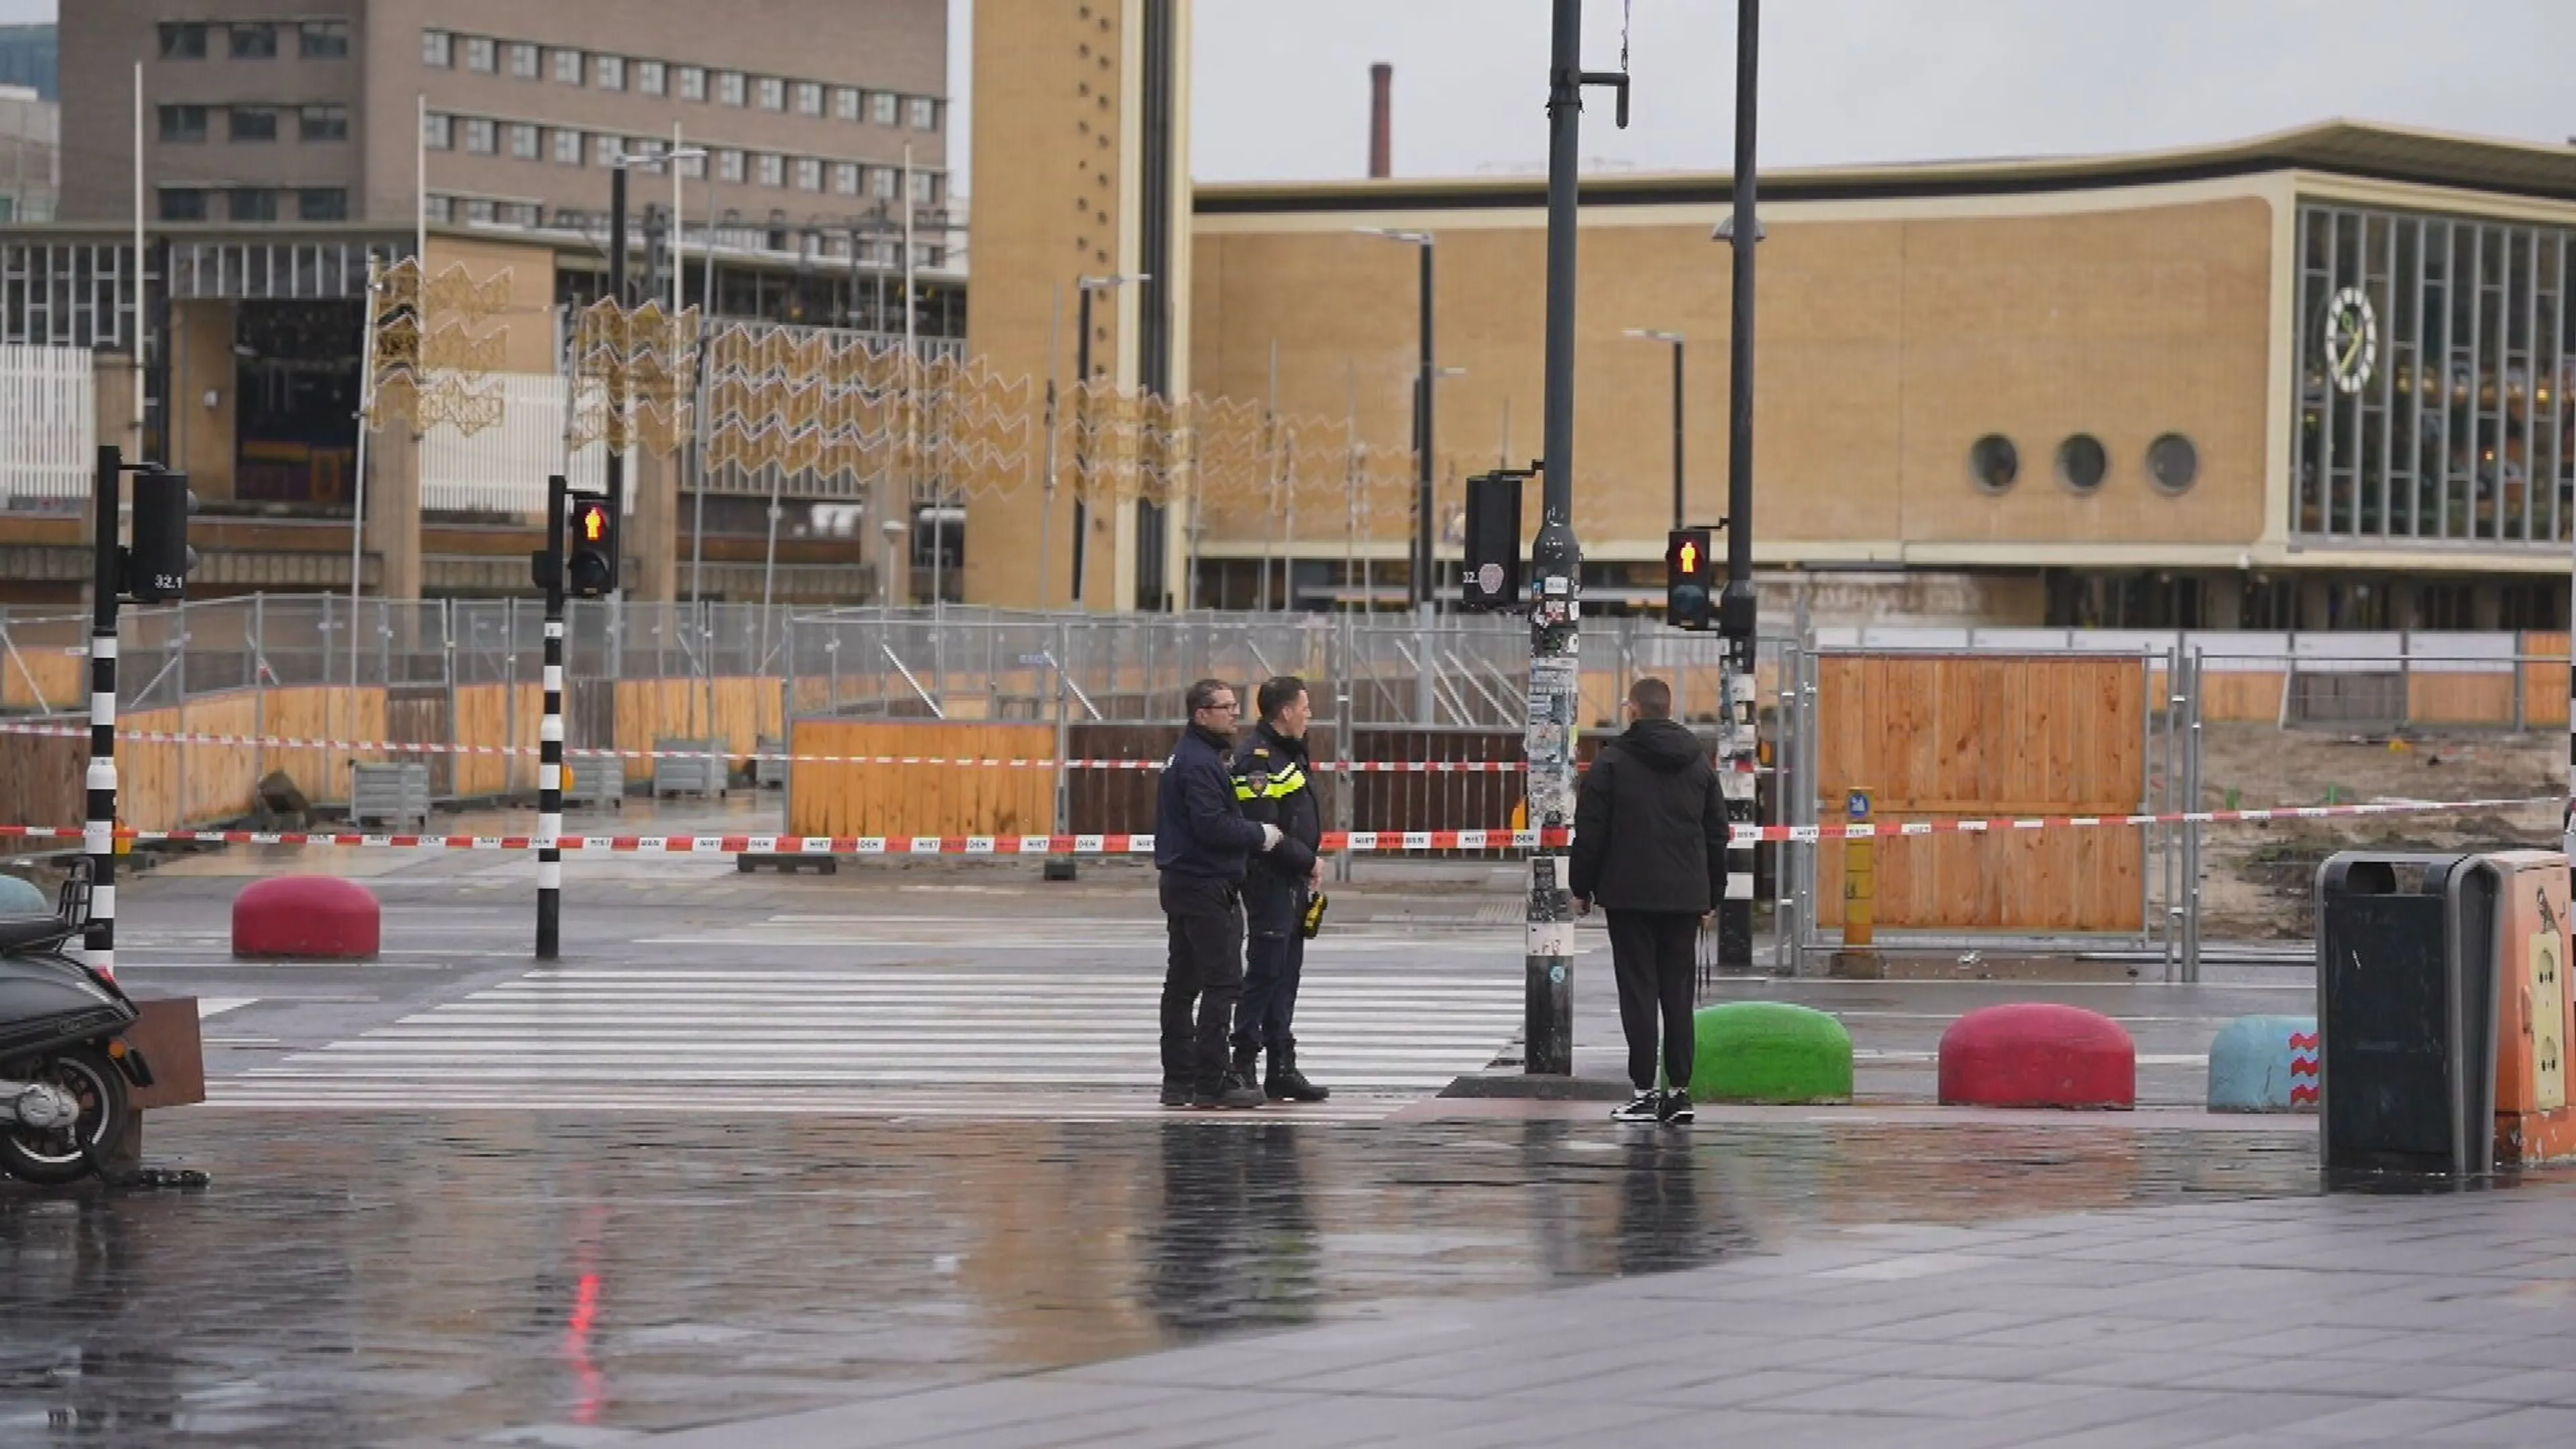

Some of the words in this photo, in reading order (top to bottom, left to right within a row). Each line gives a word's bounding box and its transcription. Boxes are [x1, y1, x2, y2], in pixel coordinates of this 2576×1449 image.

[154, 574, 182, 589] 32.1
[918, 840, 938, 848] NIET
[1028, 840, 1046, 848] NIET
